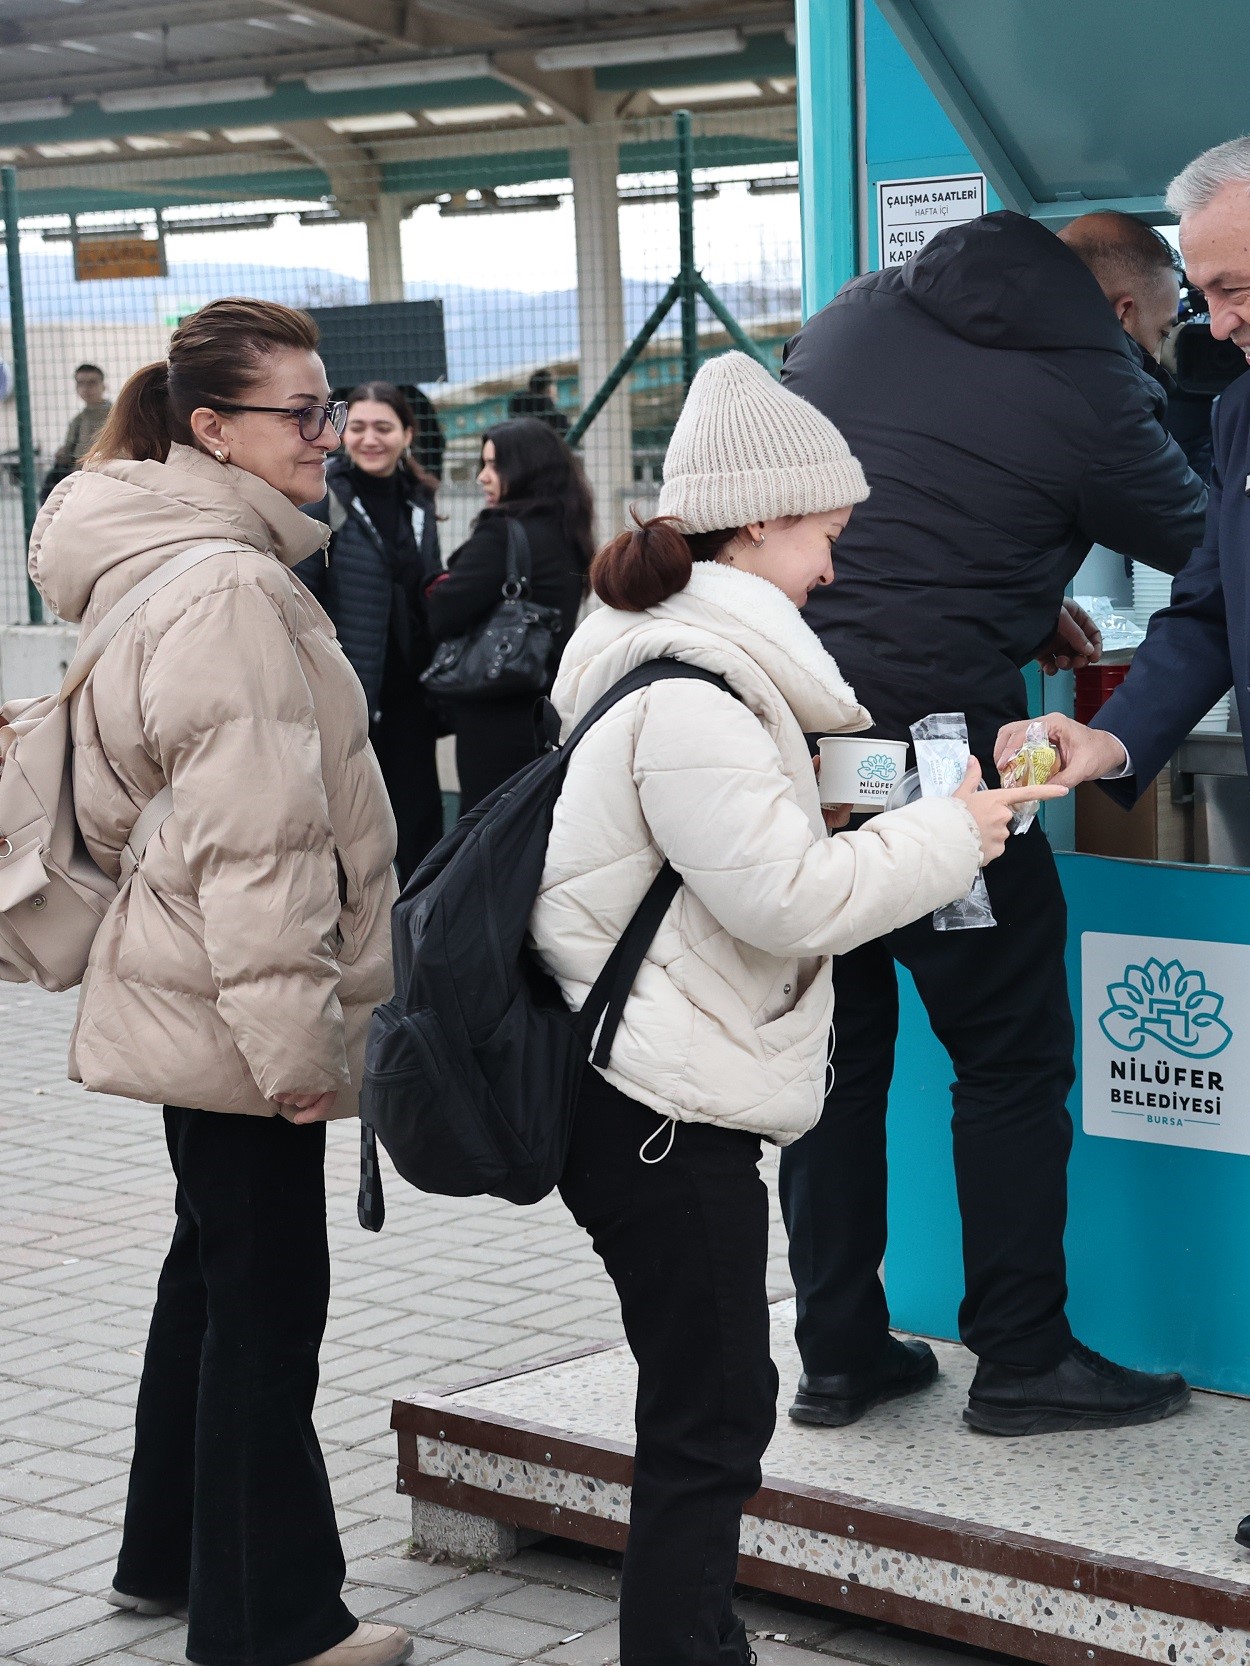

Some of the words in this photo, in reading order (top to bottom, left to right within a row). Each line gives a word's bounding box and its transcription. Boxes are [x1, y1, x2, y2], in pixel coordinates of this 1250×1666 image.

[886, 194, 930, 208] ÇALIŞMA
[932, 186, 977, 202] SAATLERİ
[914, 208, 938, 216] HAFTA
[939, 205, 949, 216] İÇİ
[889, 230, 925, 246] AÇILIŞ
[1110, 1057, 1224, 1091] NİLÜFER
[1110, 1088, 1221, 1115] BELEDİYESİ
[1146, 1114, 1183, 1126] BURSA
